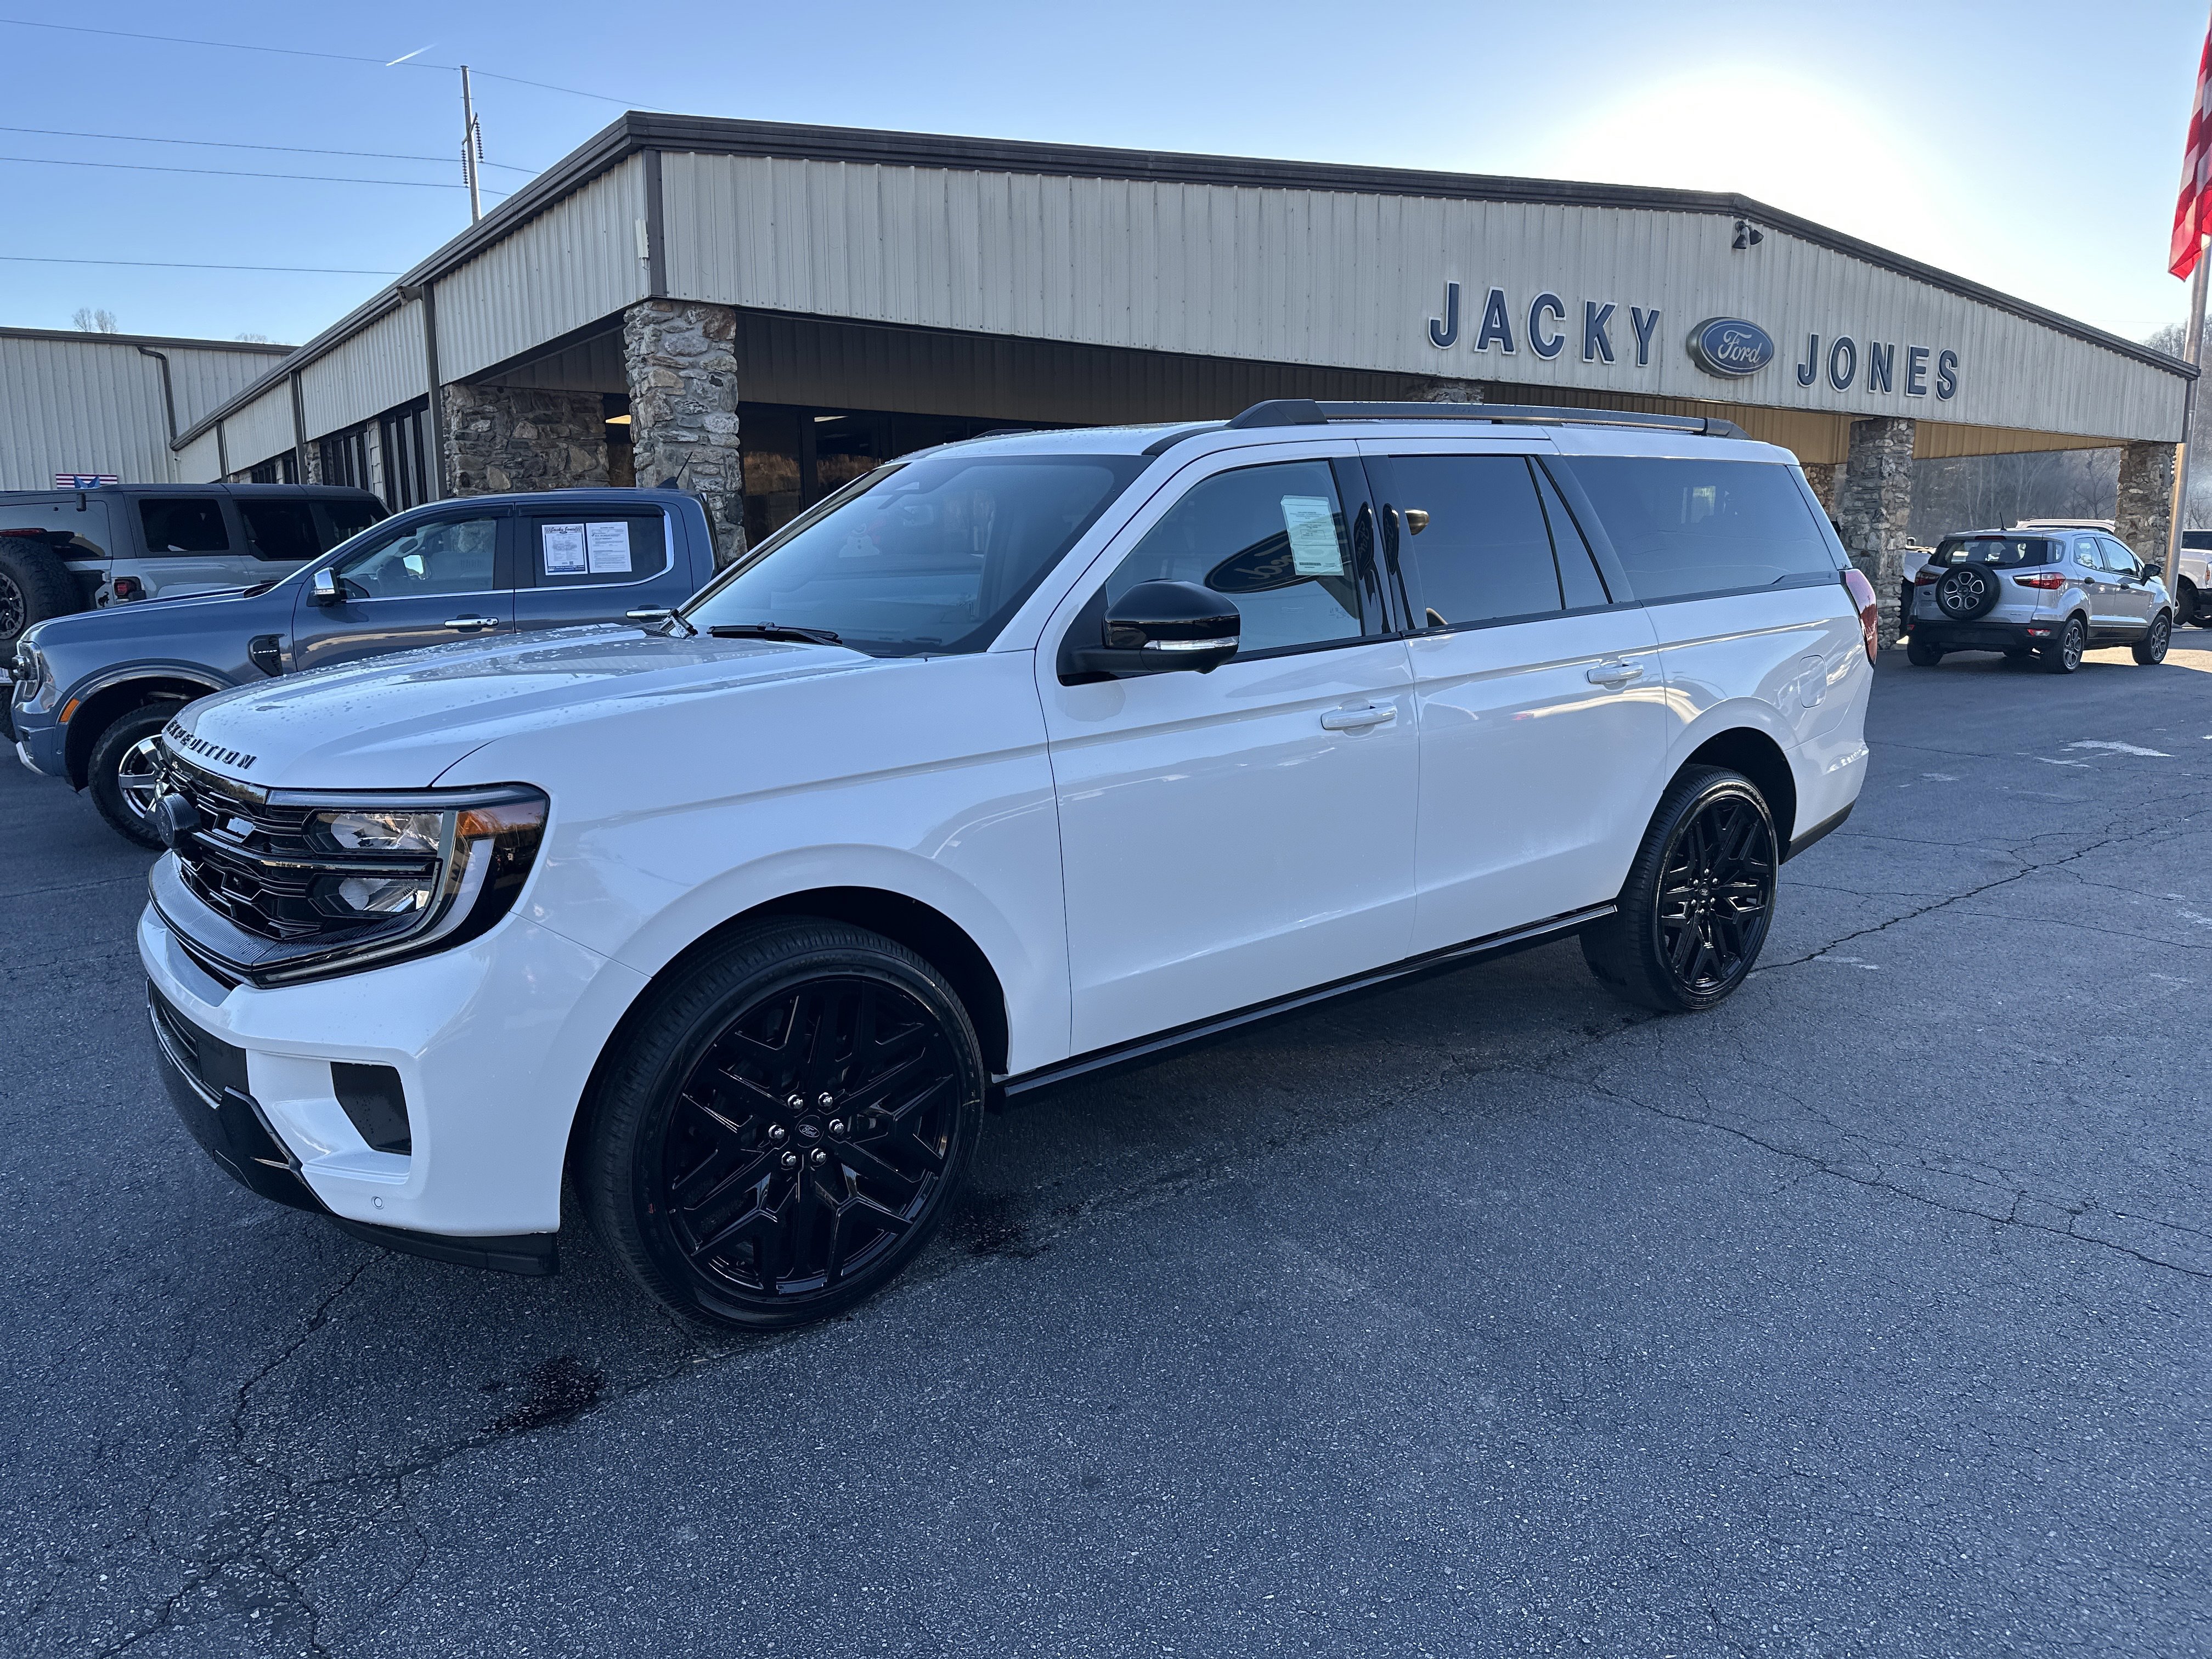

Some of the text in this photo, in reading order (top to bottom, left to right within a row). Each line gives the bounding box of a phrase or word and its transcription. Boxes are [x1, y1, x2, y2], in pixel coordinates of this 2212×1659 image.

[1428, 280, 1959, 401] JACKY Ford JONES
[166, 719, 258, 770] EXPEDITION
[802, 1125, 817, 1136] Ford
